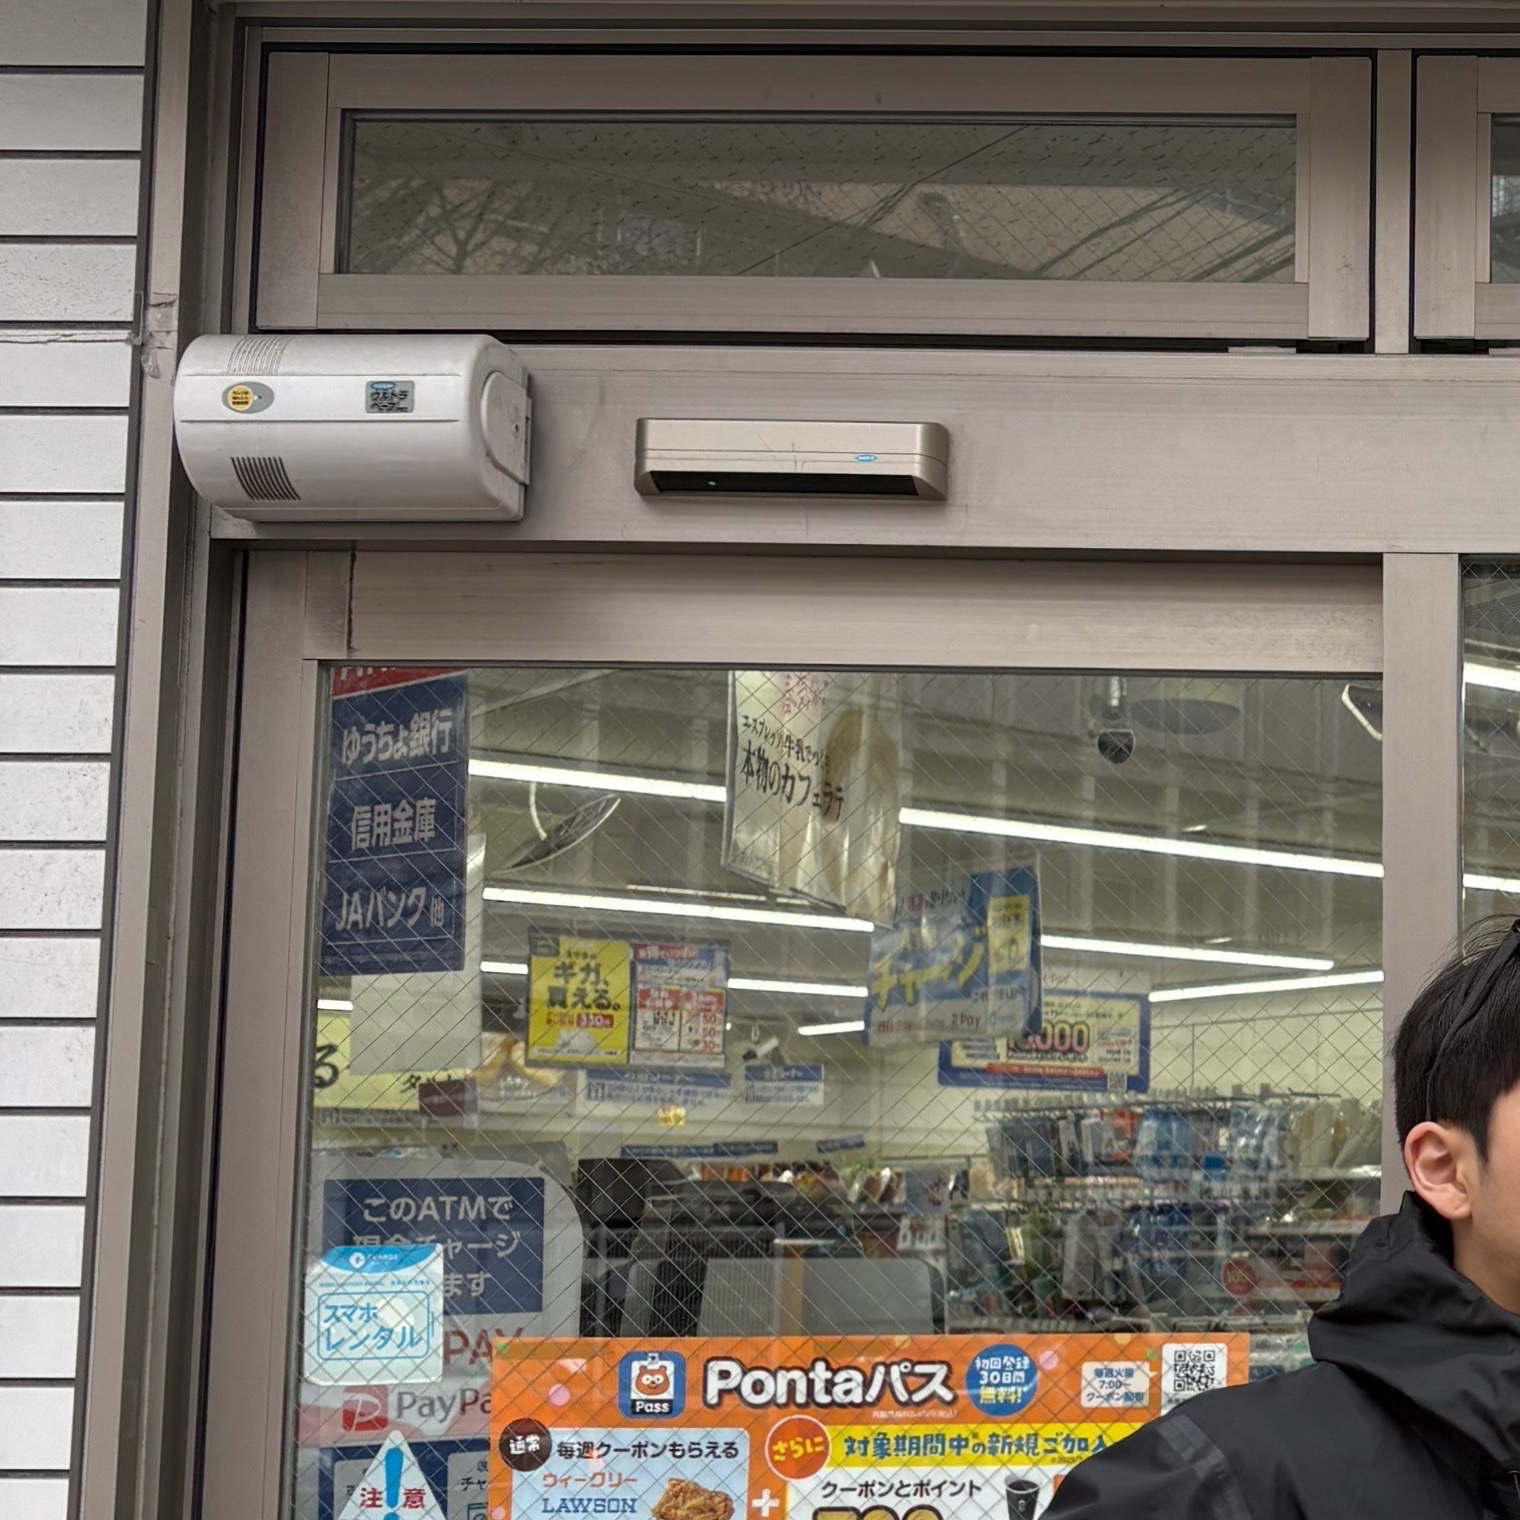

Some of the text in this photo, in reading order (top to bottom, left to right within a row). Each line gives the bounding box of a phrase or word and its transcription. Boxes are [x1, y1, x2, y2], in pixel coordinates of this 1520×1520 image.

[342, 709, 453, 764] ゆうちょ銀行
[740, 738, 844, 822] 本物のカフェラテ
[352, 798, 437, 850] 信用金庫
[363, 1196, 514, 1223] このATMで
[324, 1303, 378, 1323] スマホ
[323, 1326, 422, 1351] レンタル
[975, 1355, 1031, 1371] 初回登録
[704, 1356, 954, 1408] Pontaパス
[979, 1371, 1026, 1384] 30日間
[396, 1388, 492, 1424] PayPa
[634, 1400, 670, 1414] Pass
[508, 1434, 541, 1455] 通常
[557, 1440, 739, 1460] 毎週クーポンもらえる
[773, 1436, 825, 1460] さらに
[541, 1471, 638, 1488] ウィークリー
[822, 1480, 983, 1499] クーポンとポイント
[541, 1498, 638, 1513] LAWSON
